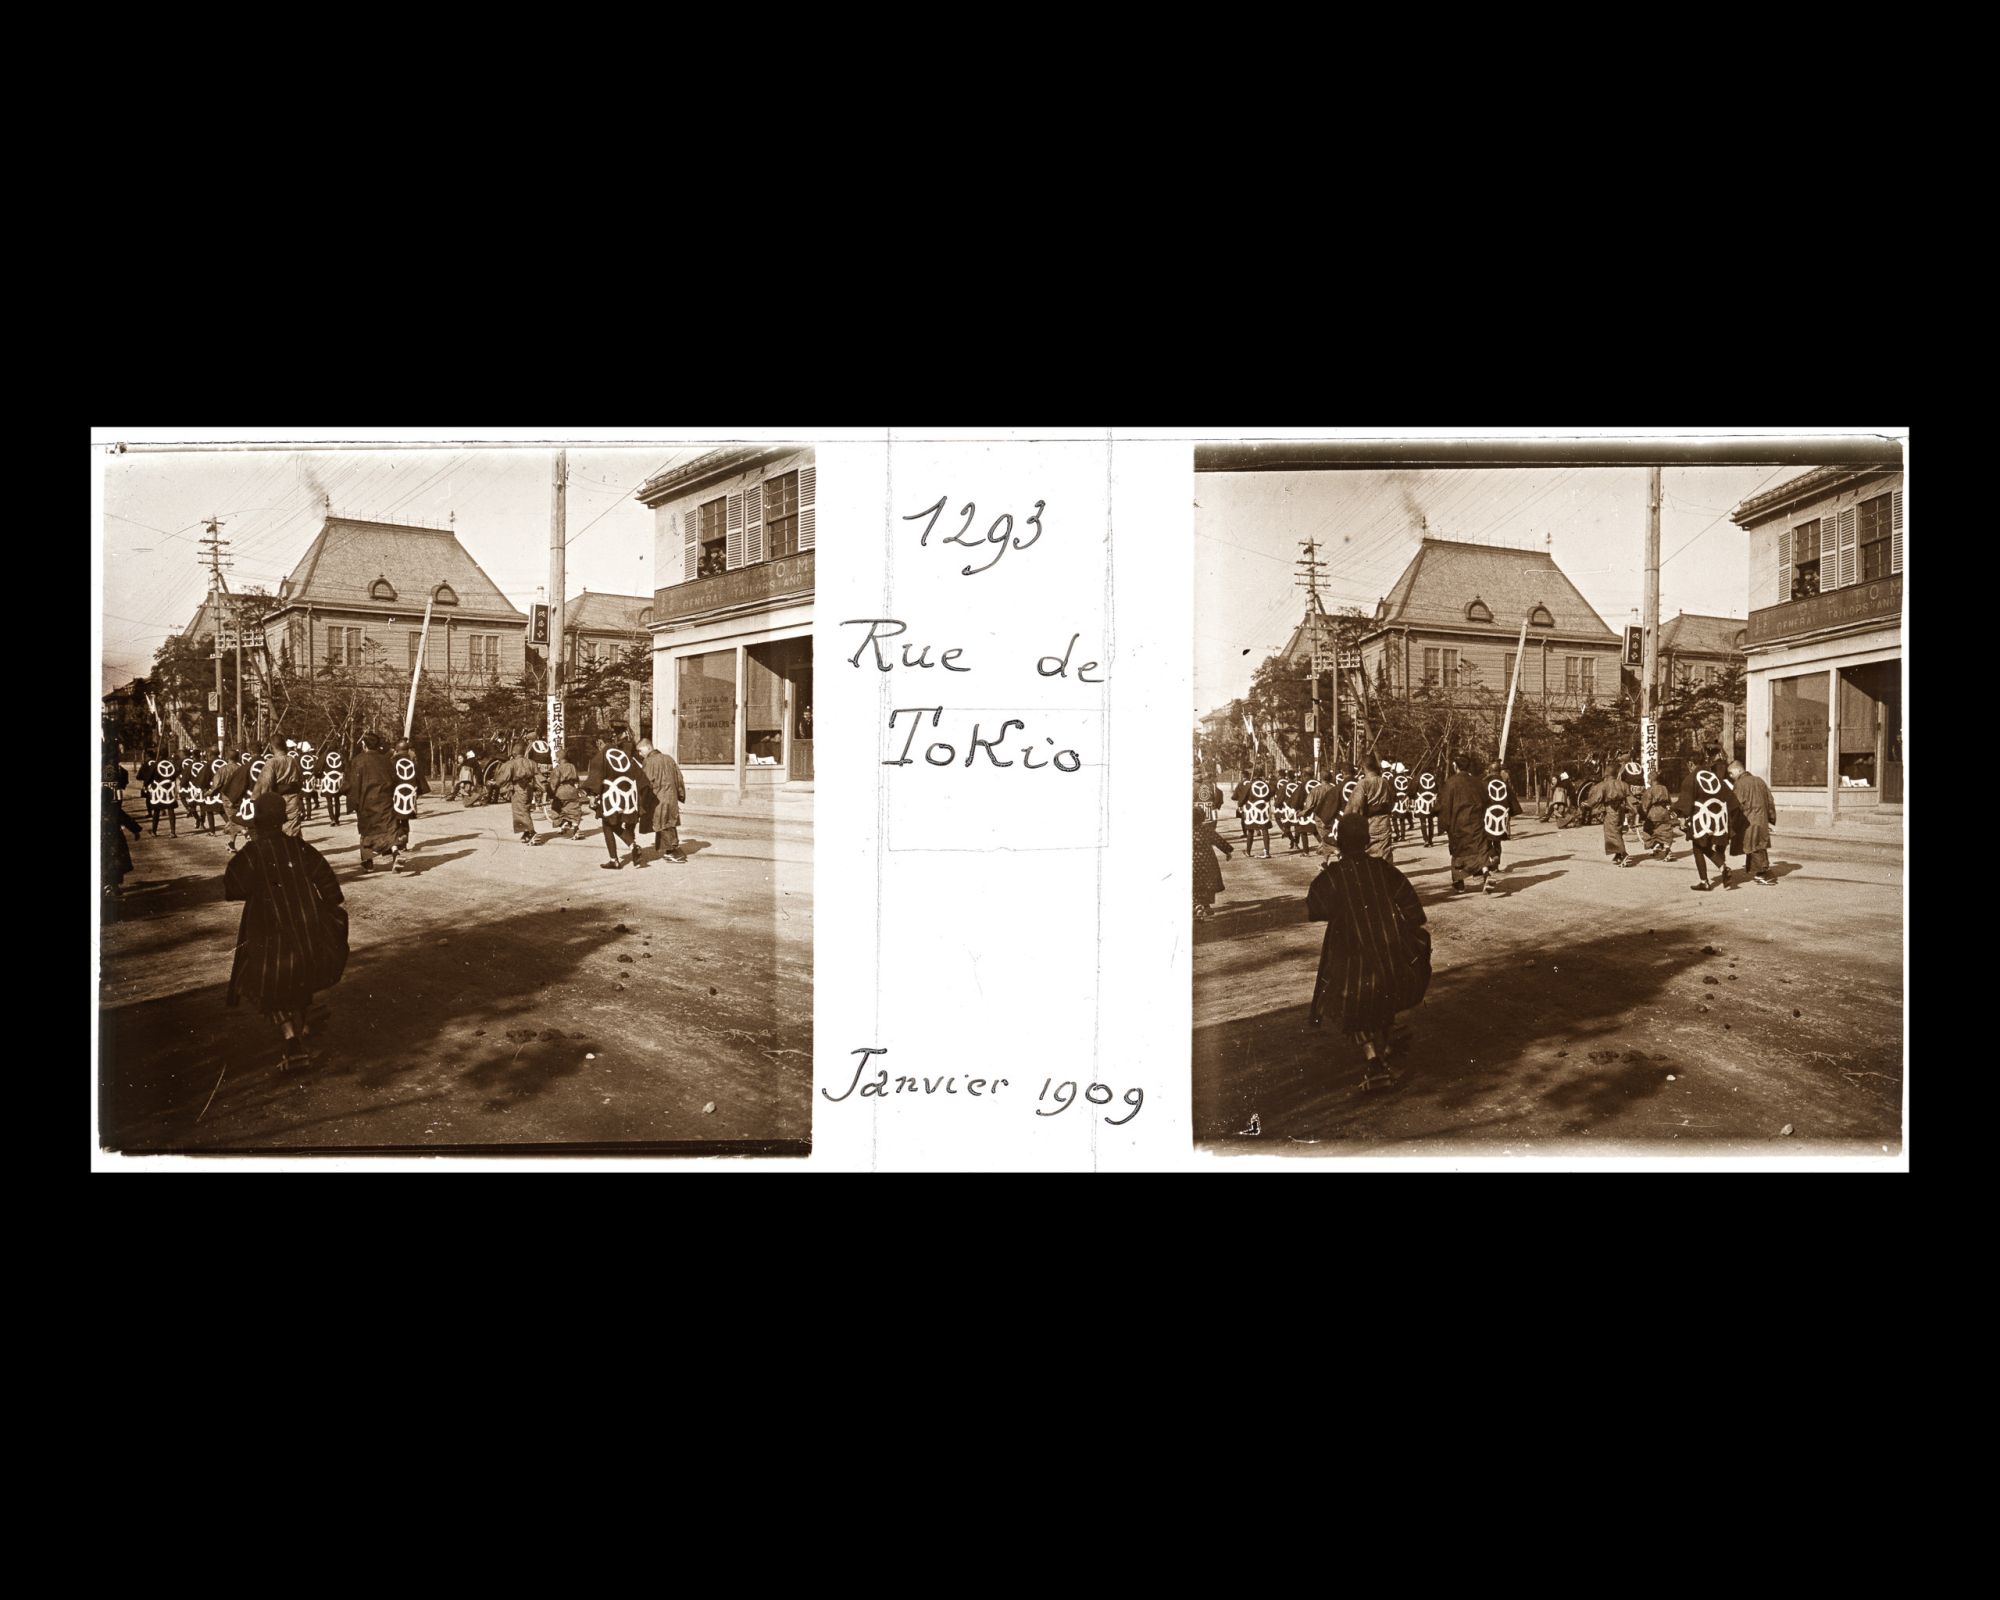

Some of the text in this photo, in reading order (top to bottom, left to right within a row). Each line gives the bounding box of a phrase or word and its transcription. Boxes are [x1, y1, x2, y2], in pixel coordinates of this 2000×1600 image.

[902, 495, 1046, 576] 1293
[839, 618, 1104, 682] Rue de
[821, 1047, 1144, 1125] Janvier 1909
